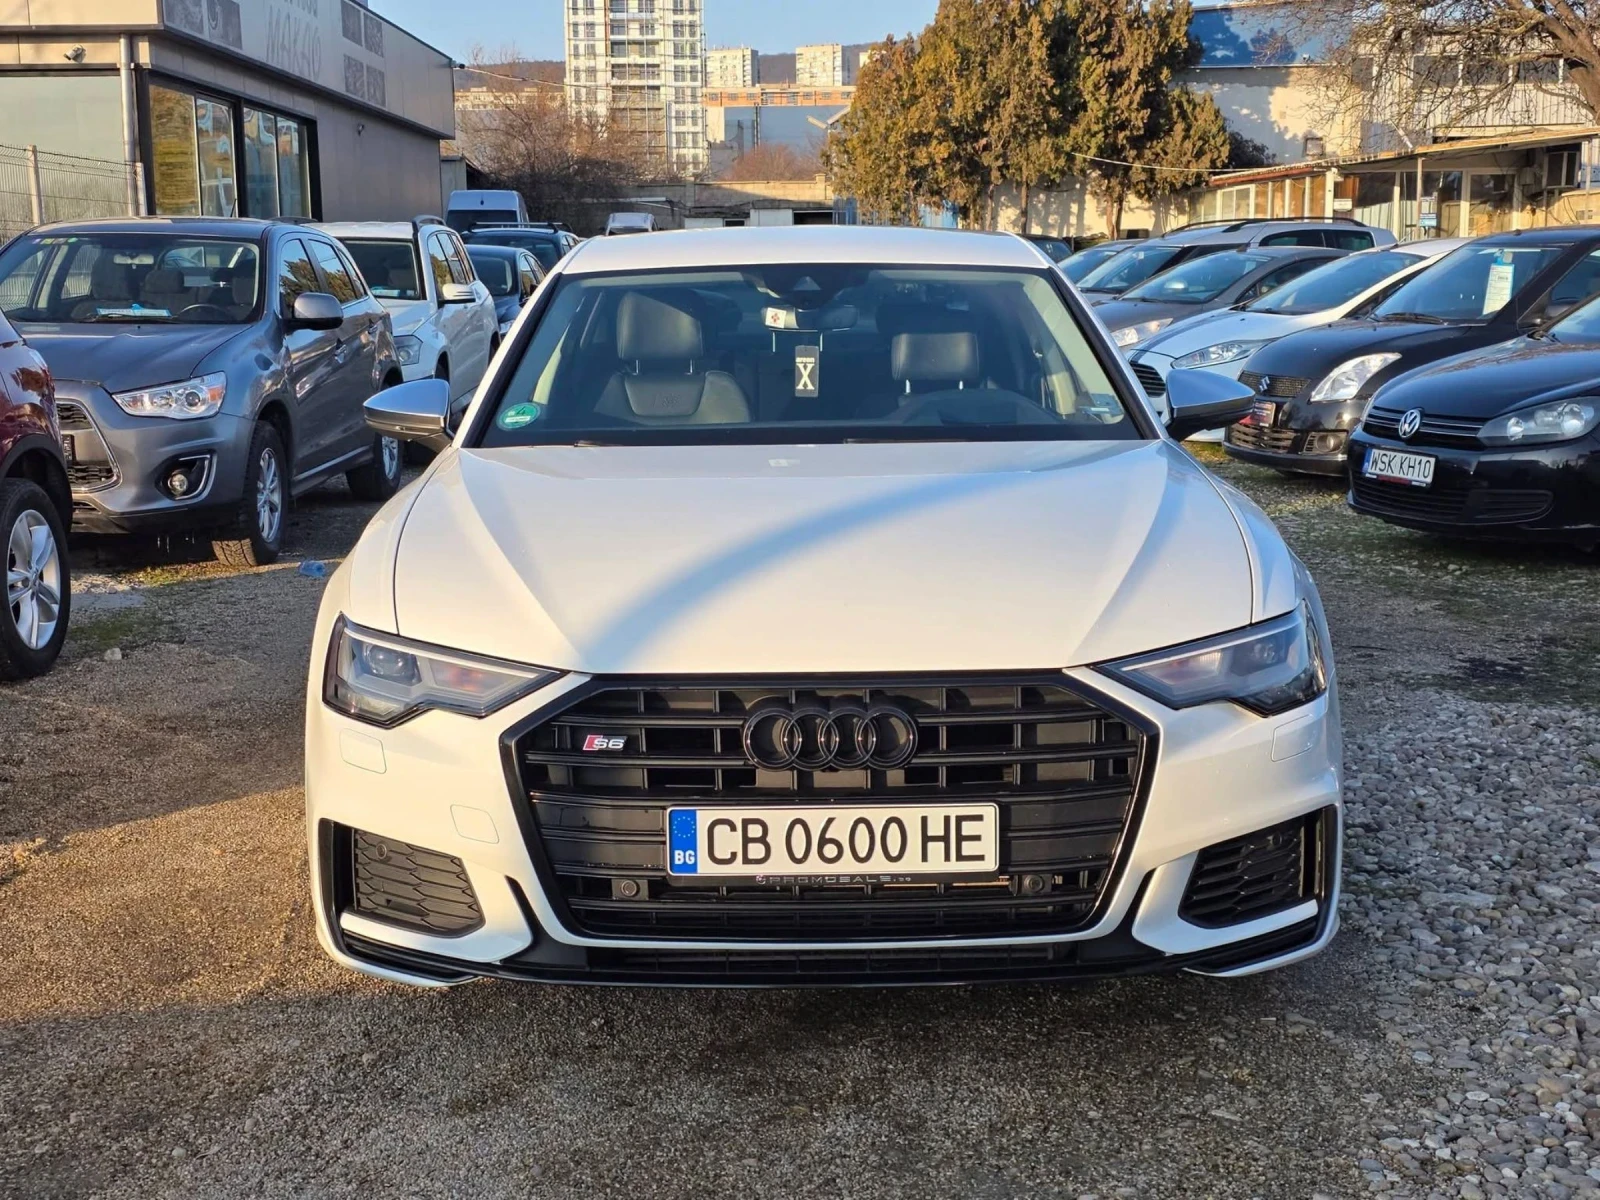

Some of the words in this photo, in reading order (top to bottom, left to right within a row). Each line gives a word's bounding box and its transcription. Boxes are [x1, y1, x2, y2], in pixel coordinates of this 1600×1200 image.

[796, 363, 815, 390] X
[1370, 451, 1397, 475] WSK
[1399, 455, 1432, 479] KH10
[592, 738, 625, 749] S6
[706, 817, 772, 866] CB
[785, 815, 908, 864] 0600
[920, 813, 986, 863] HE
[674, 849, 696, 865] BG
